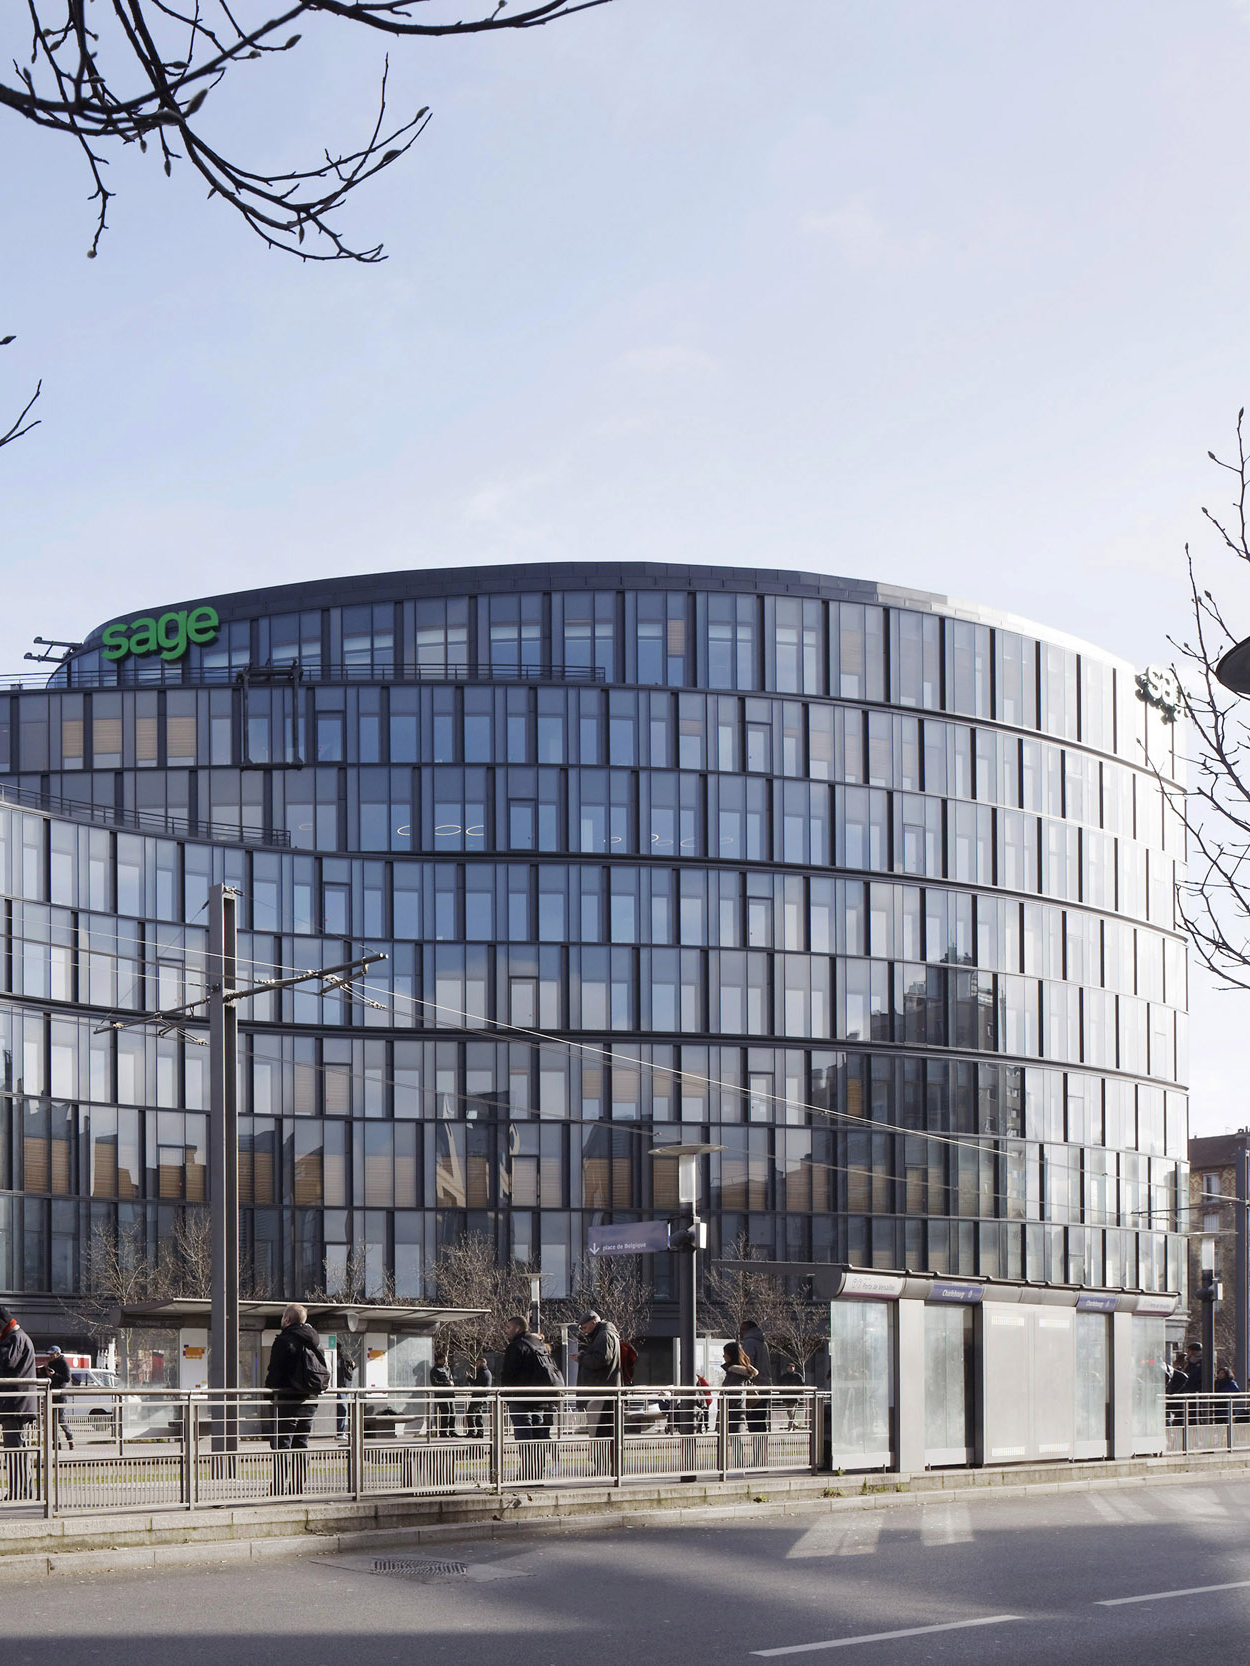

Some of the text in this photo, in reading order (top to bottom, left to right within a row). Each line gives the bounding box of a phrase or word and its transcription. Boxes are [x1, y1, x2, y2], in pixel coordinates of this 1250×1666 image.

[102, 606, 219, 661] sage
[602, 1244, 616, 1252] place
[624, 1242, 647, 1250] Belgique
